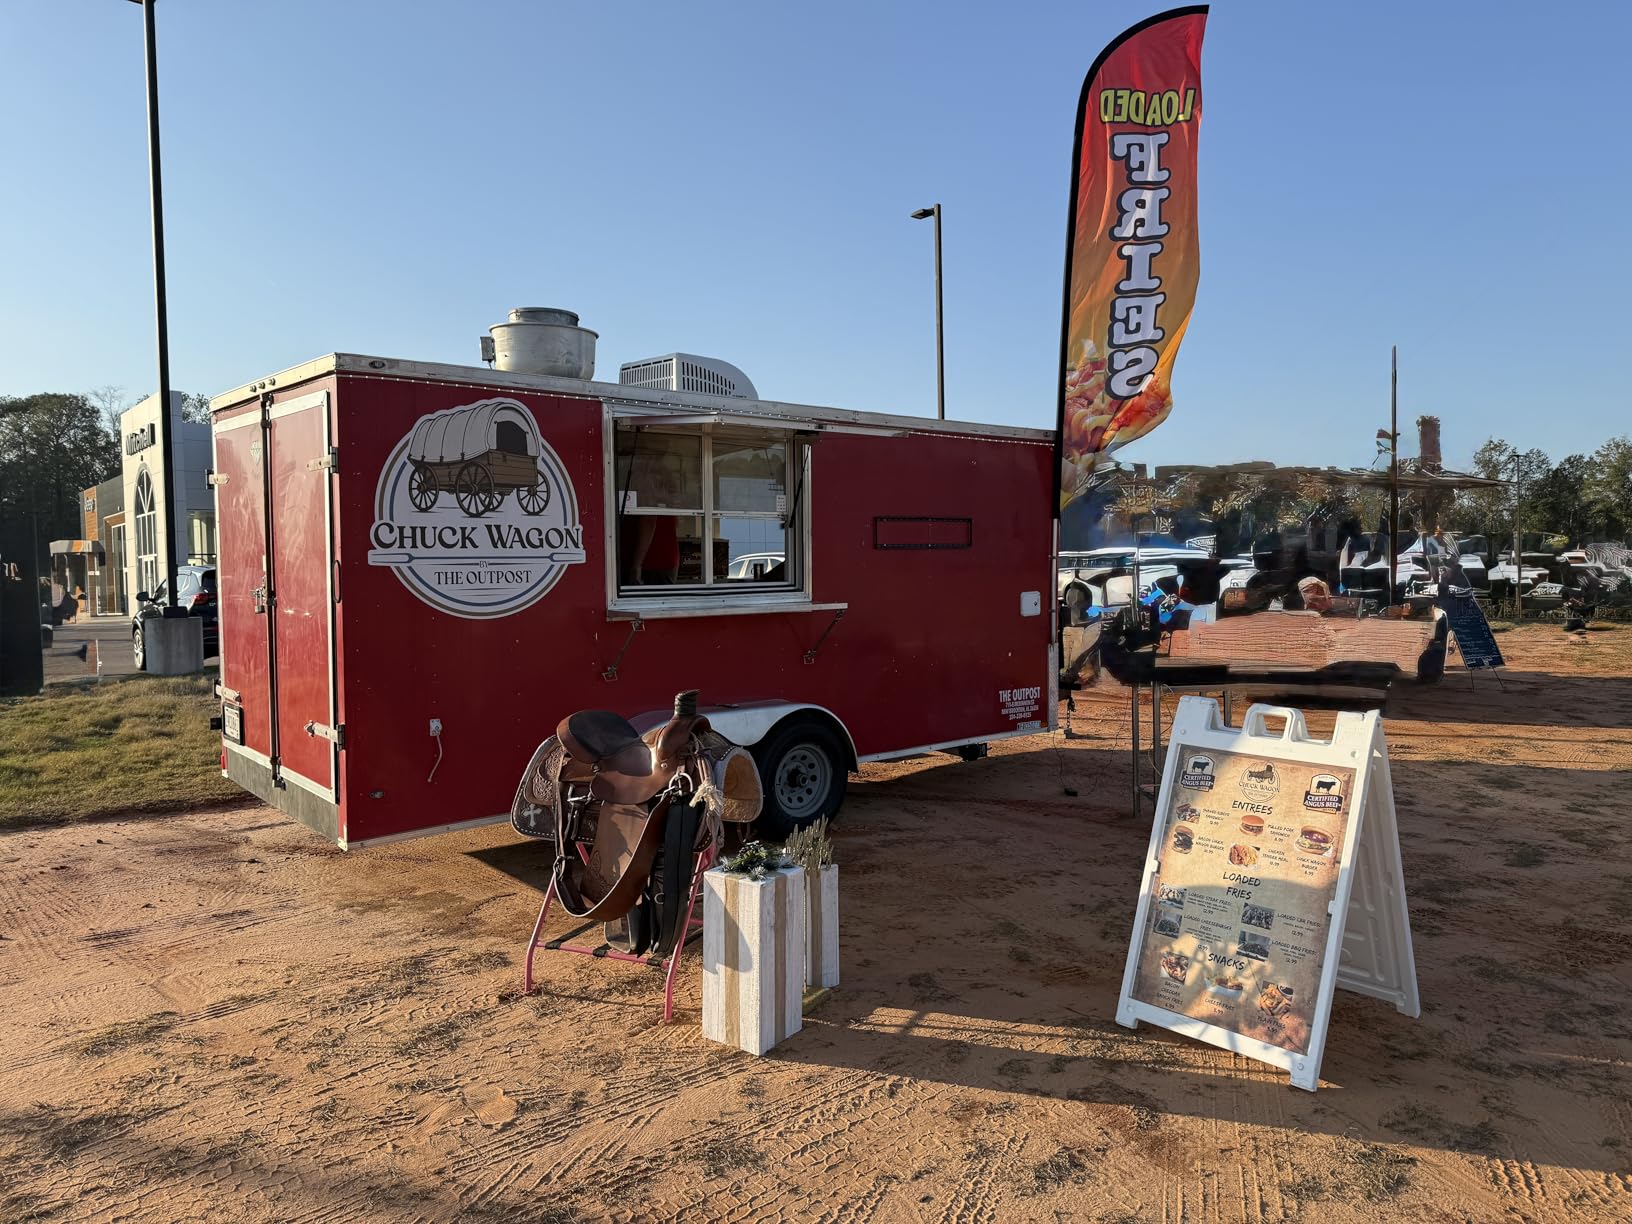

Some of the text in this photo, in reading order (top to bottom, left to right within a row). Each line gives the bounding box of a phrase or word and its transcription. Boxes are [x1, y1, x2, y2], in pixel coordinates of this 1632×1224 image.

[374, 522, 581, 549] CHUCK WAGON
[479, 560, 490, 569] BY
[434, 570, 532, 585] THE OUTPOST
[999, 687, 1040, 702] THE OUTPOST
[1231, 800, 1273, 815] ENTREES
[1304, 799, 1325, 807] ANGUS
[1223, 872, 1261, 887] LOADED
[1226, 887, 1252, 899] FRIES
[1278, 913, 1296, 921] LOADED
[1272, 940, 1290, 949] LOADED
[1208, 953, 1245, 971] SNACKS
